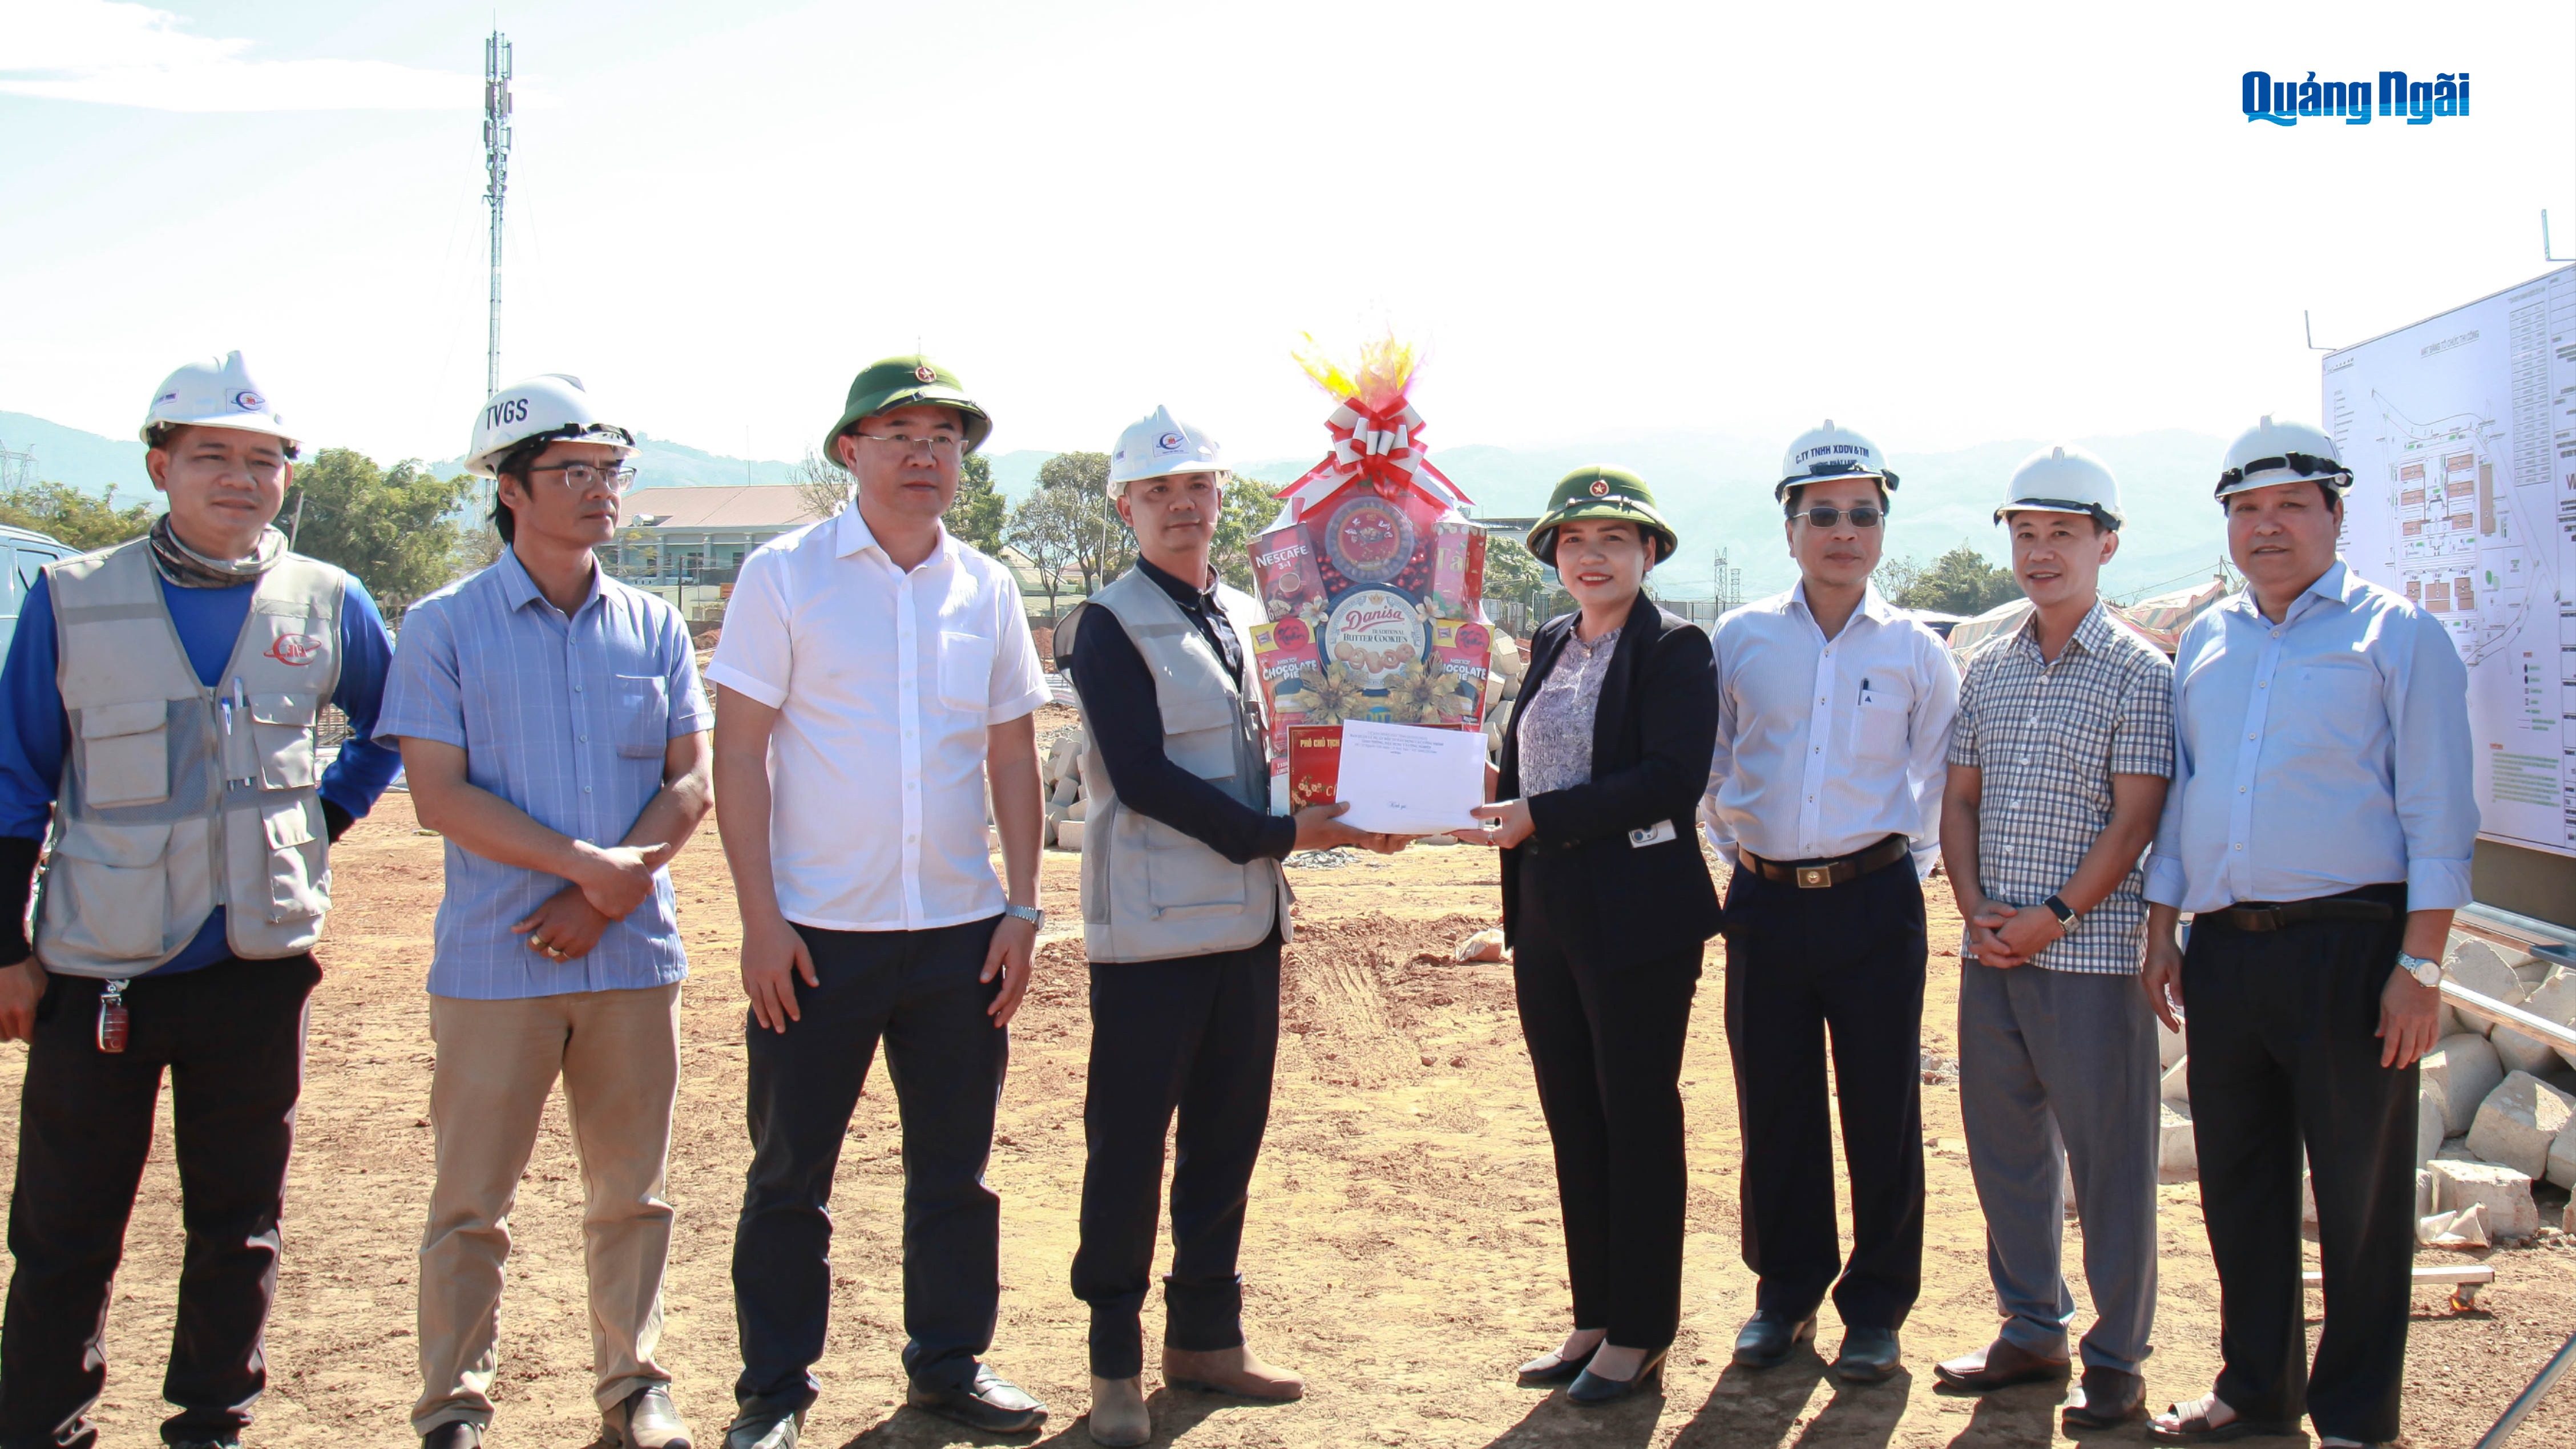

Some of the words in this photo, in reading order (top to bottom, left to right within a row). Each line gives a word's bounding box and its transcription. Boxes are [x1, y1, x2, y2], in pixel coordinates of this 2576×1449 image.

[487, 398, 529, 430] TVGS
[1796, 450, 1810, 464] C.TY
[1811, 445, 1831, 457] TNHH
[1437, 548, 1470, 573] Tài
[1341, 606, 1405, 632] Danisa
[1343, 633, 1373, 642] BUTTER
[1374, 634, 1407, 643] COOKIES
[1283, 670, 1299, 680] PIE
[1301, 738, 1312, 748] PHÓ
[1314, 737, 1326, 747] CHỦ
[1327, 739, 1340, 749] TỊCH
